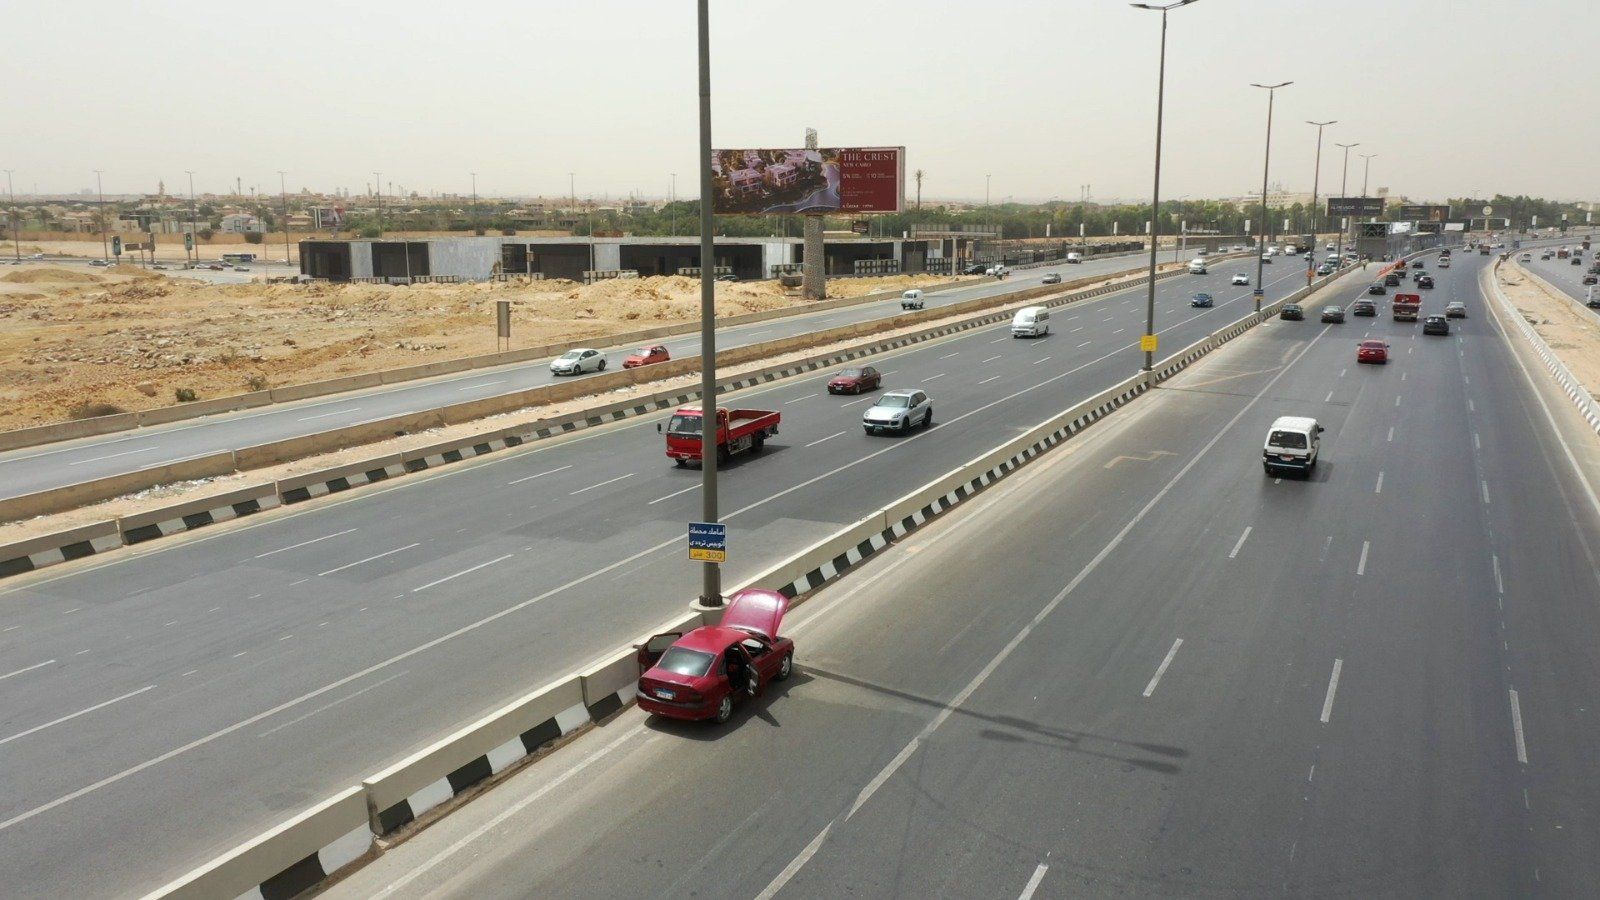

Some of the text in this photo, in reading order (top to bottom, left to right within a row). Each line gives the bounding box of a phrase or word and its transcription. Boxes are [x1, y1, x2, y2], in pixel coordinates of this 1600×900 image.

[843, 152, 895, 161] THE CREST
[706, 551, 722, 559] 300
